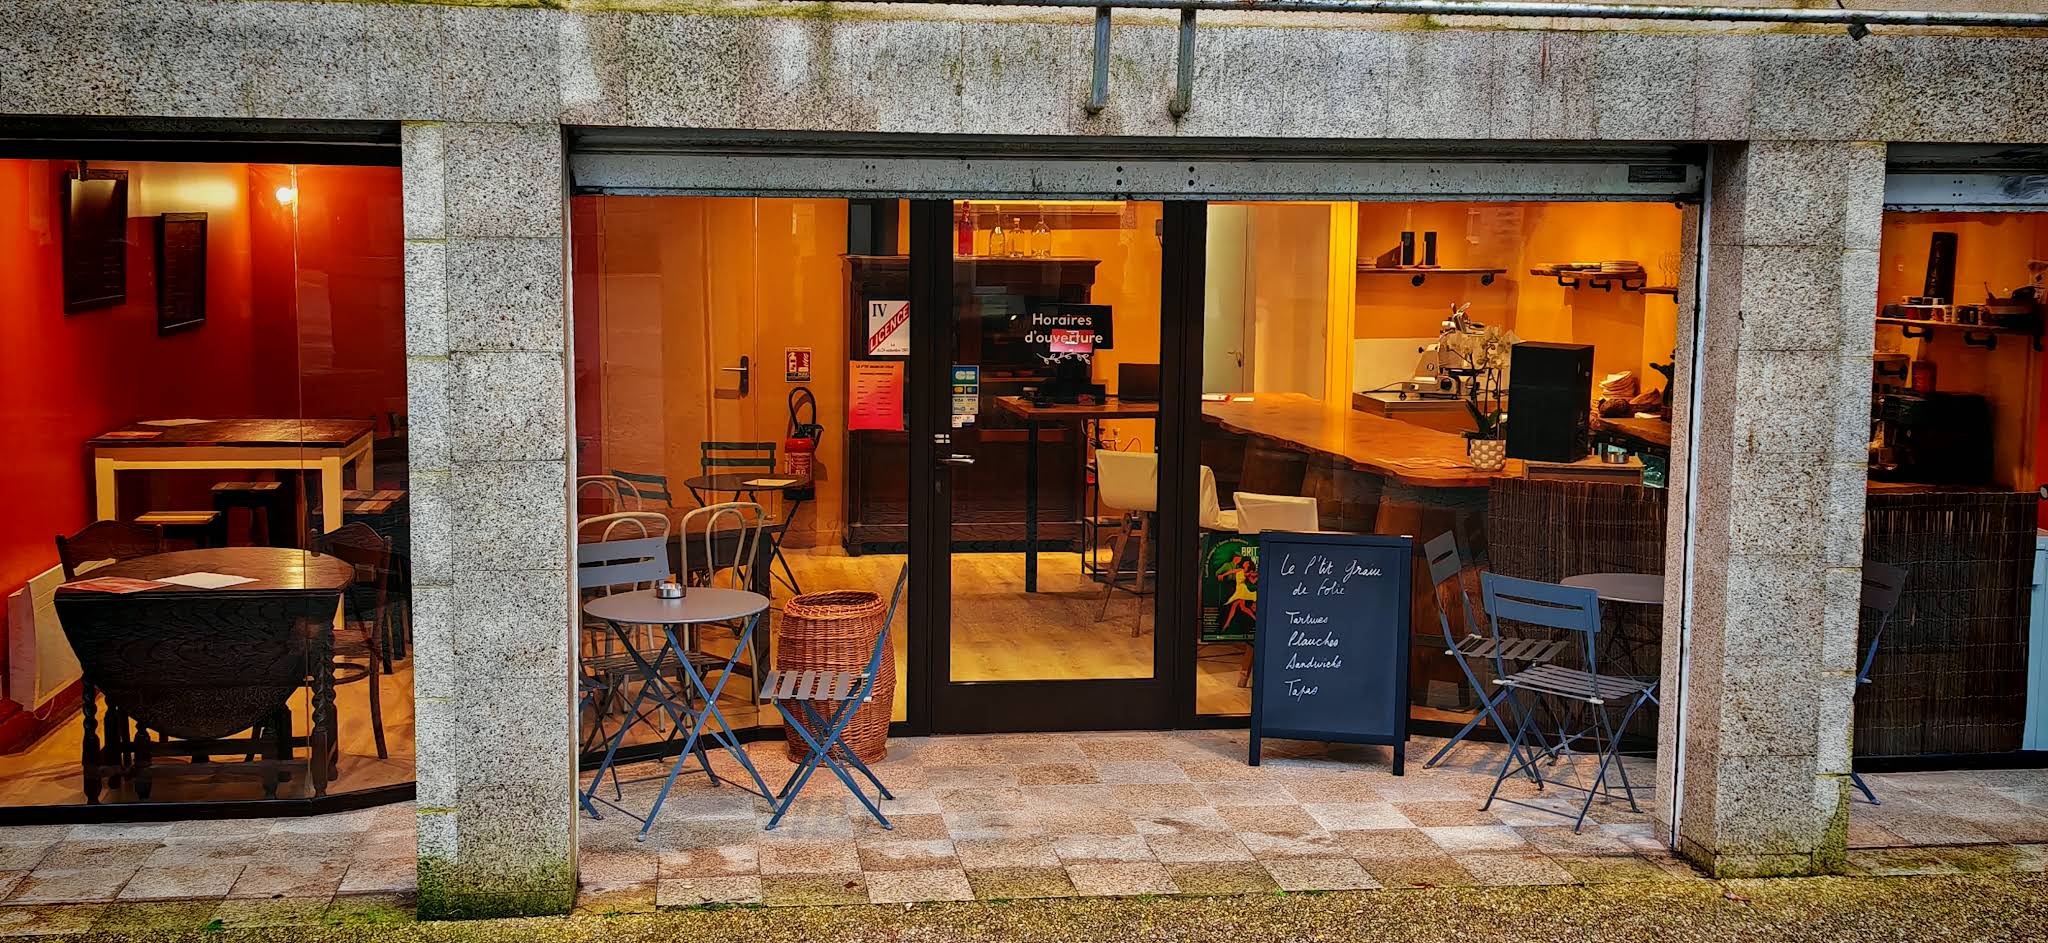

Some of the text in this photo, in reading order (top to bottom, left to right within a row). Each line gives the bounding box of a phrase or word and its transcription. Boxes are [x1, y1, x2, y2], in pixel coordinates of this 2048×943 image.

[872, 303, 887, 317] IV
[1032, 312, 1093, 326] Horaires
[870, 304, 909, 351] LICENCE
[1024, 329, 1104, 344] d'ouverture
[1280, 553, 1296, 576] Le
[1292, 582, 1309, 596] de
[1287, 630, 1339, 648] Planches
[1284, 678, 1319, 702] Tapas
